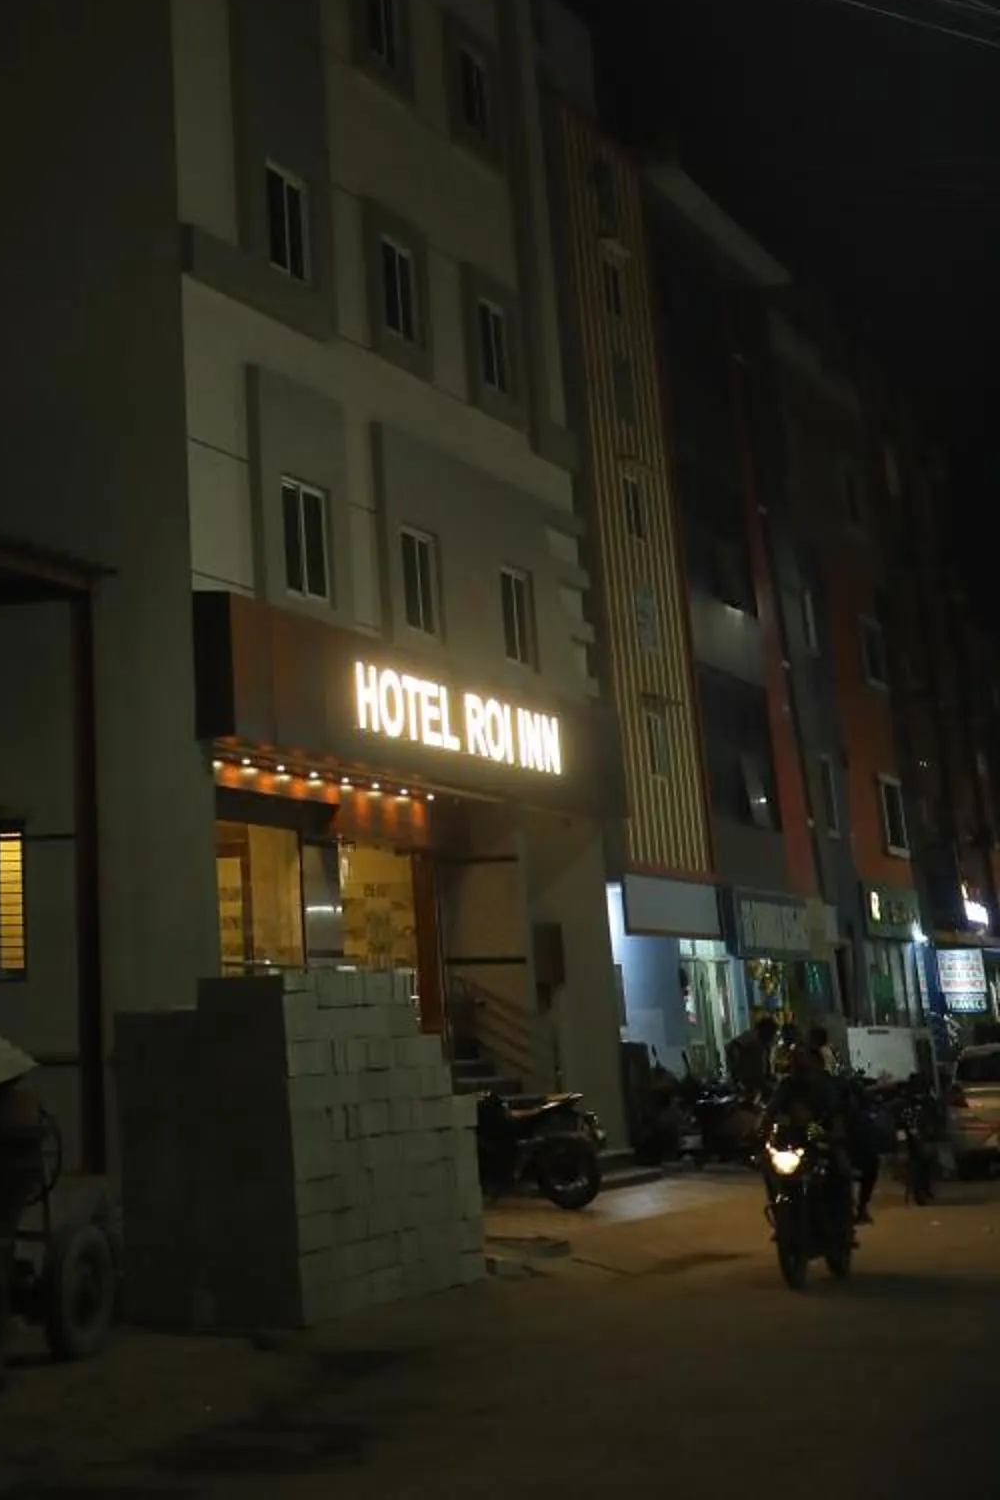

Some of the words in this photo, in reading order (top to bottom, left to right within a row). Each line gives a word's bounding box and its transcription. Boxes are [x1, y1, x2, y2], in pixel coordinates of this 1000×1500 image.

[354, 660, 461, 752] HOTEL
[463, 692, 515, 766] ROI
[517, 707, 562, 776] INN
